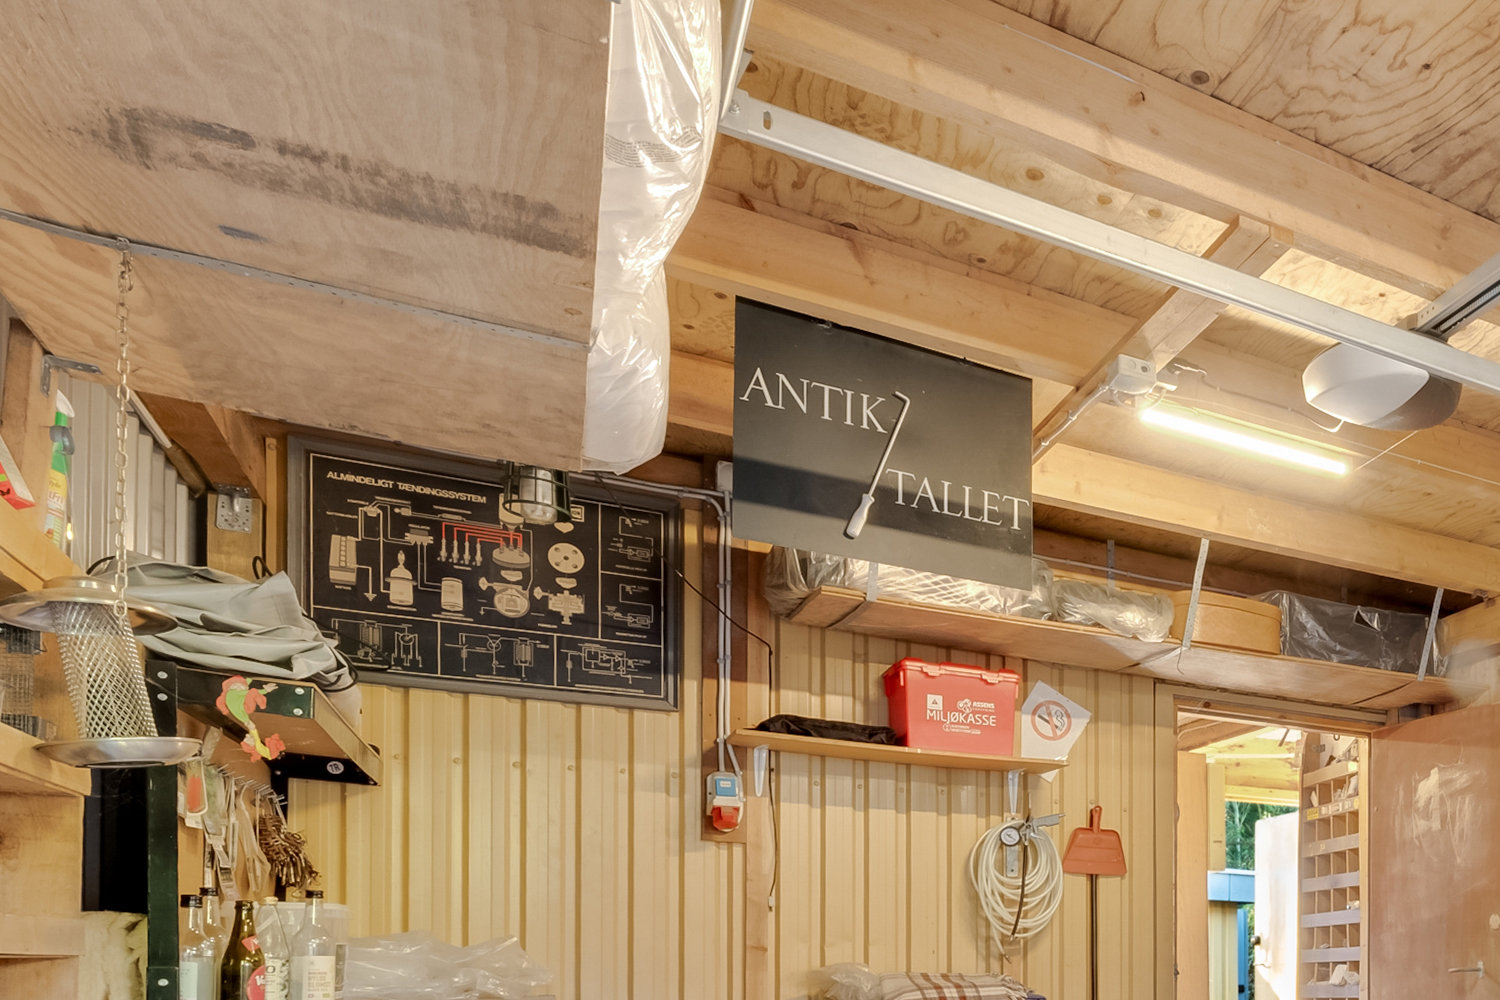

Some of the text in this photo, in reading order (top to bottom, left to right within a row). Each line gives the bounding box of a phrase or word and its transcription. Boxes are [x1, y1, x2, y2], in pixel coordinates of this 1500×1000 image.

[739, 367, 888, 434] ANTIK
[326, 471, 395, 489] ALMINDELIGT
[396, 481, 487, 504] TÆNDINGSSYSTEM
[885, 468, 1030, 530] TALLET
[926, 709, 997, 727] MILJØKASSE
